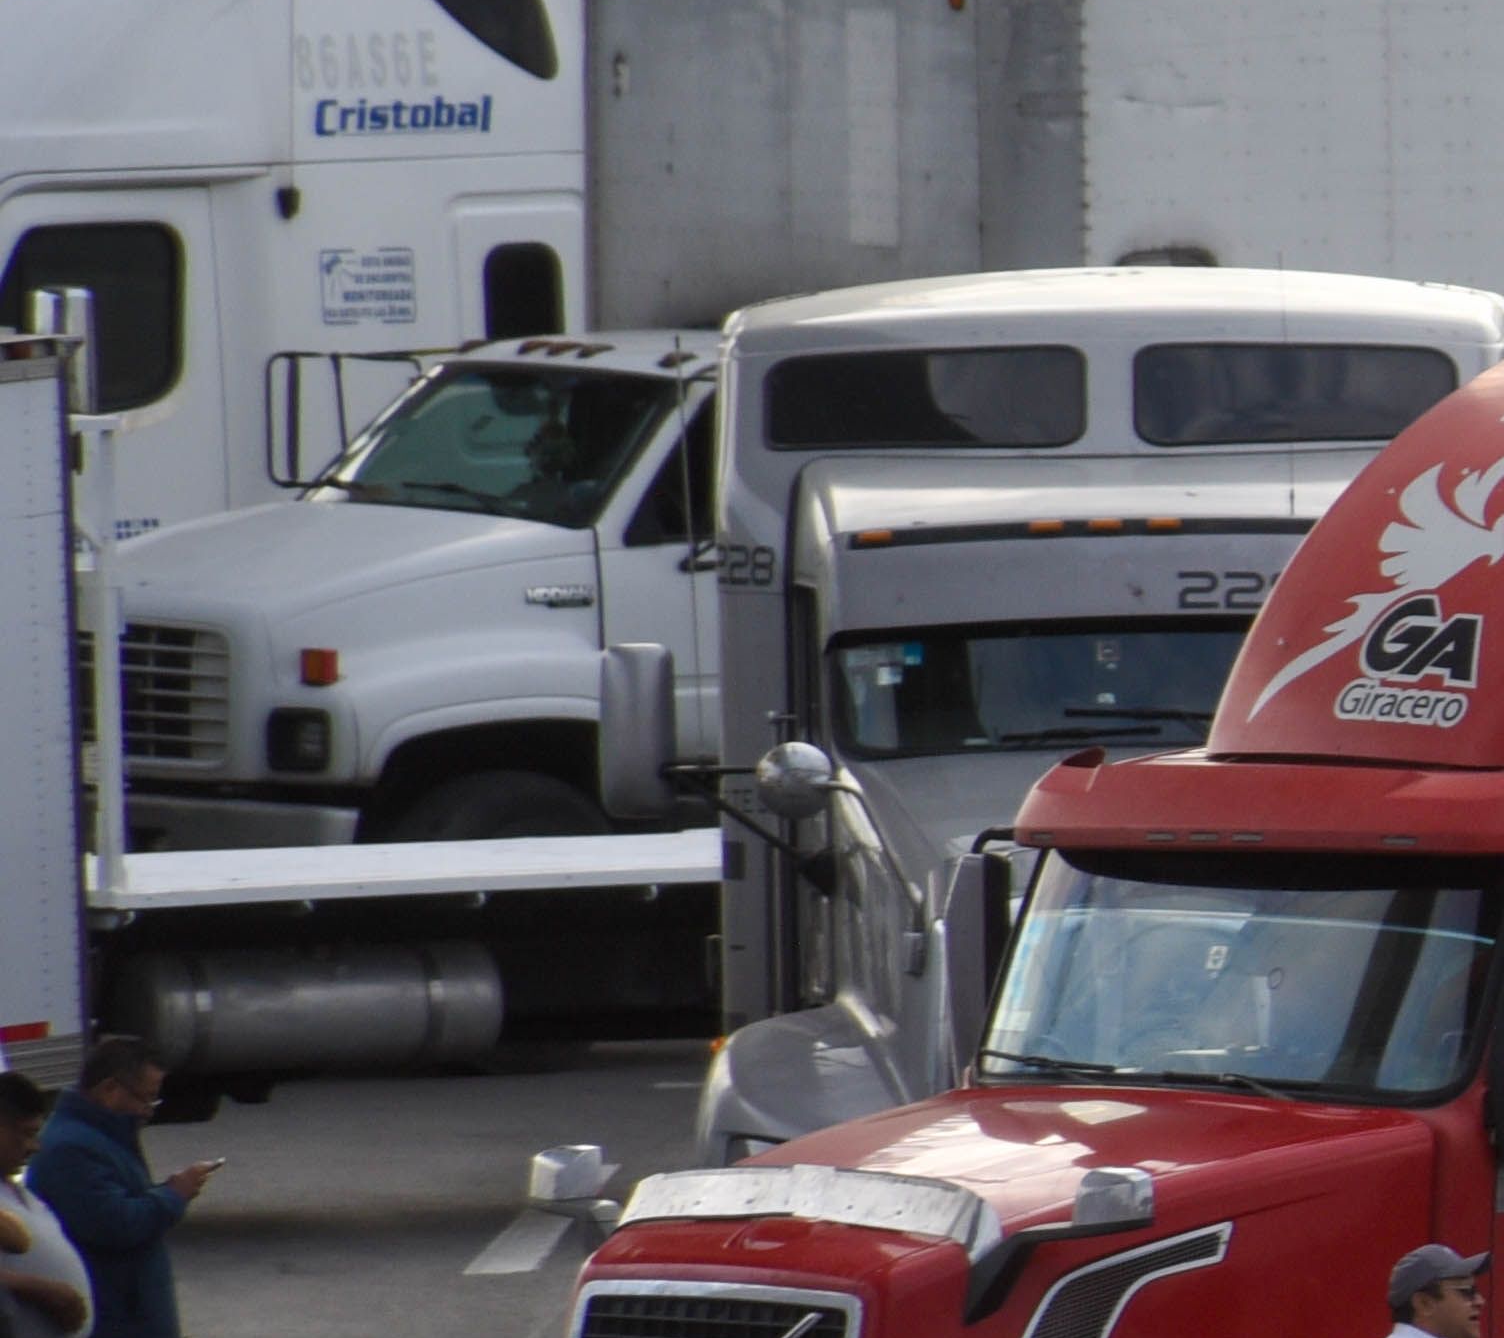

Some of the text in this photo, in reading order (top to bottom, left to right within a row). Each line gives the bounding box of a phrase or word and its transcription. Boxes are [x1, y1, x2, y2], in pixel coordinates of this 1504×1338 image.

[316, 96, 493, 137] Cristobal
[1177, 570, 1288, 610] 22
[1361, 592, 1484, 689] GA
[1340, 683, 1466, 725] Giracero
